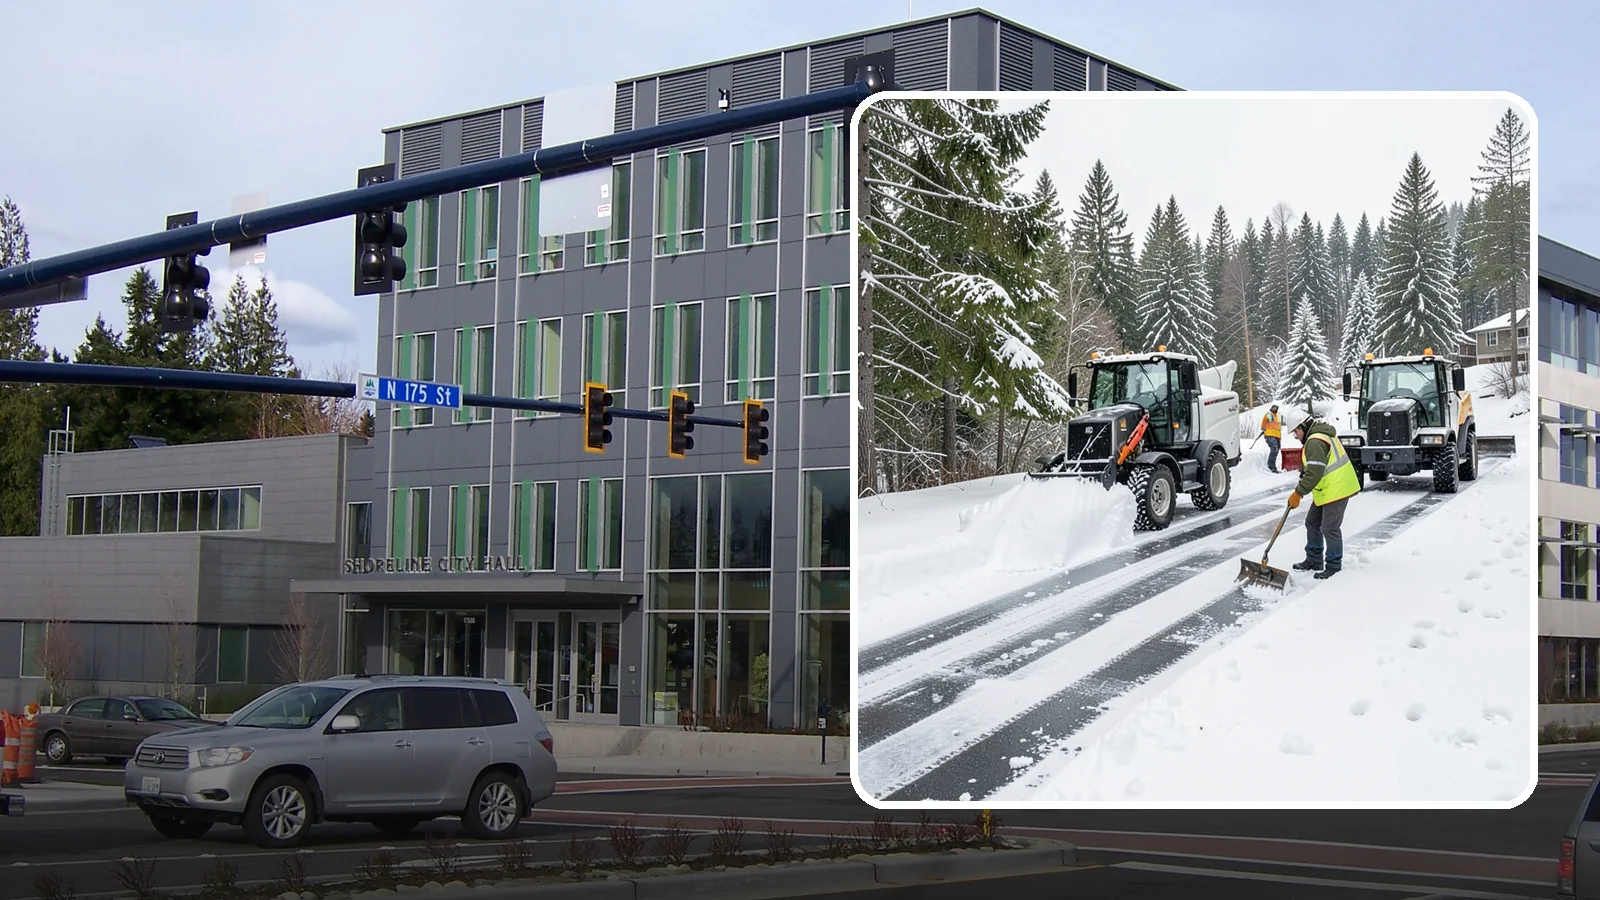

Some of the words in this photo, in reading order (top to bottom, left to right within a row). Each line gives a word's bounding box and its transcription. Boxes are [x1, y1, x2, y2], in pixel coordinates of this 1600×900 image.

[387, 380, 396, 400] N
[405, 382, 427, 403] 175
[436, 386, 451, 406] St
[343, 557, 432, 574] SHORELINE
[439, 556, 475, 572] CITY
[483, 555, 525, 571] HALL
